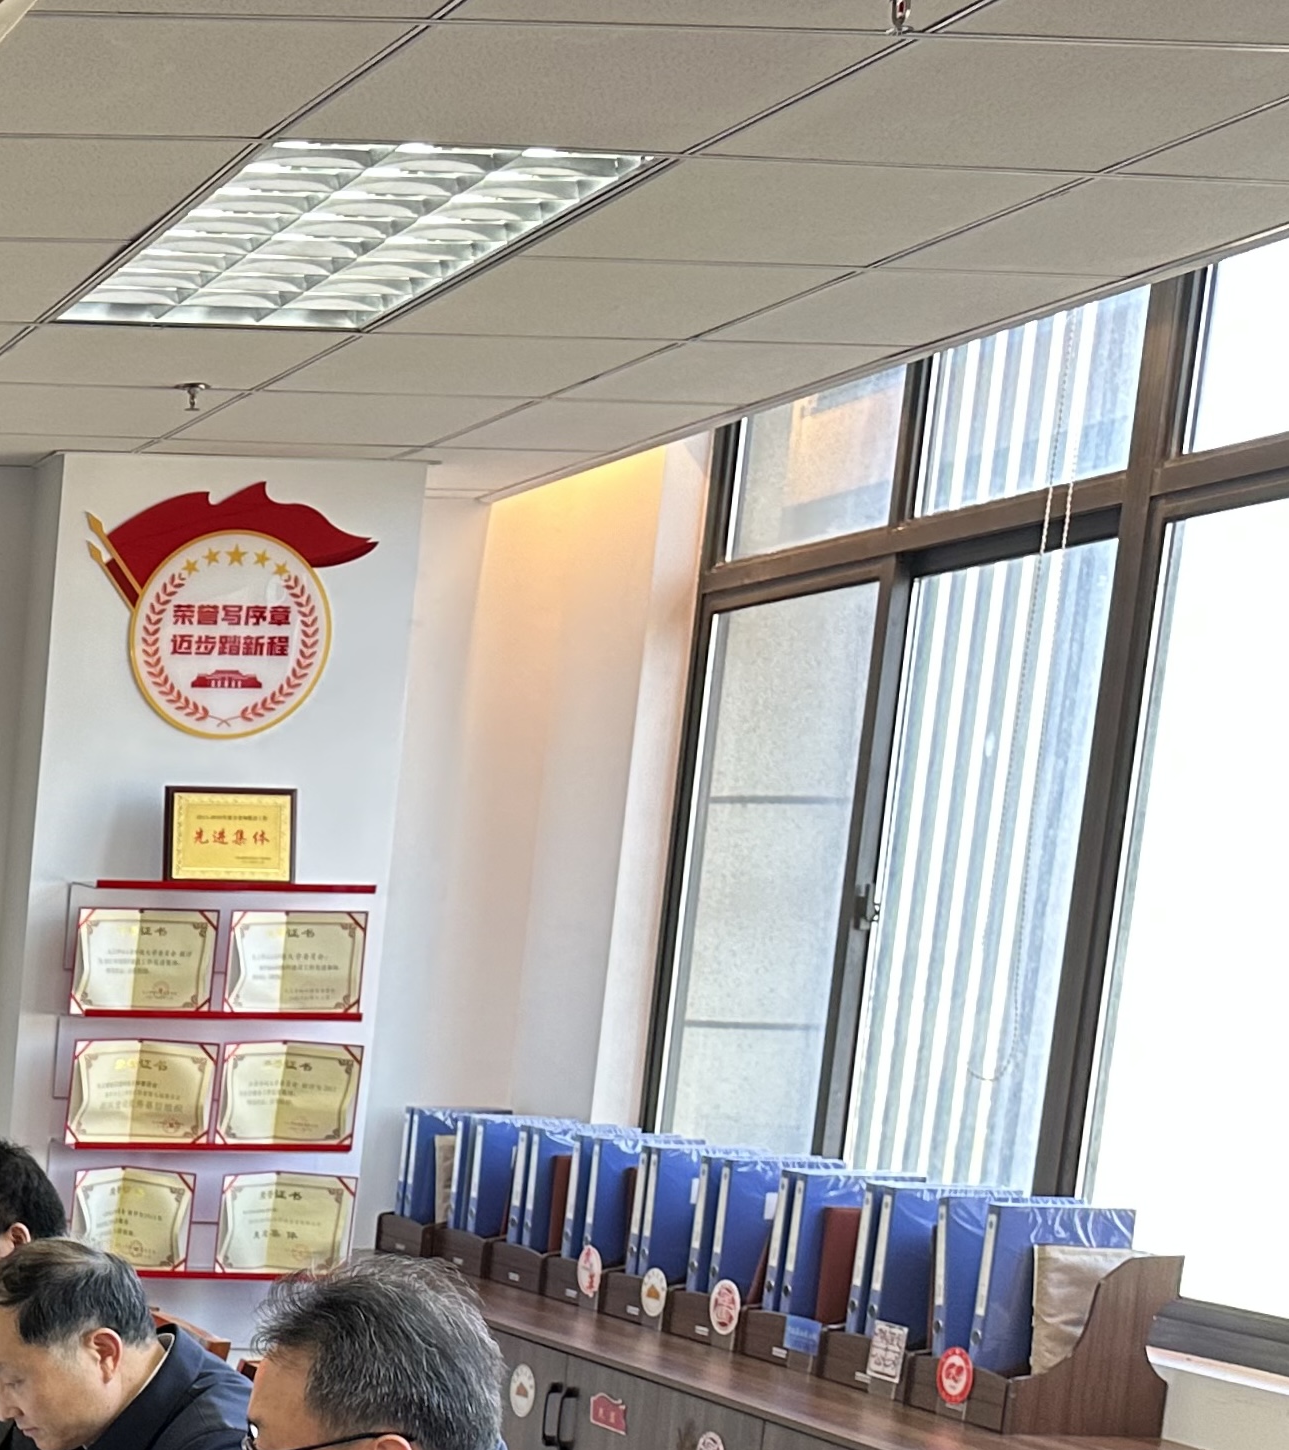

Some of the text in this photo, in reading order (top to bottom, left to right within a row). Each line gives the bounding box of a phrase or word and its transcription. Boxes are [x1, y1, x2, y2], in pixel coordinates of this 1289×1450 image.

[172, 603, 292, 627] 荣誉写序章
[170, 633, 290, 657] 迈步踏新程
[194, 827, 270, 846] 先进集体
